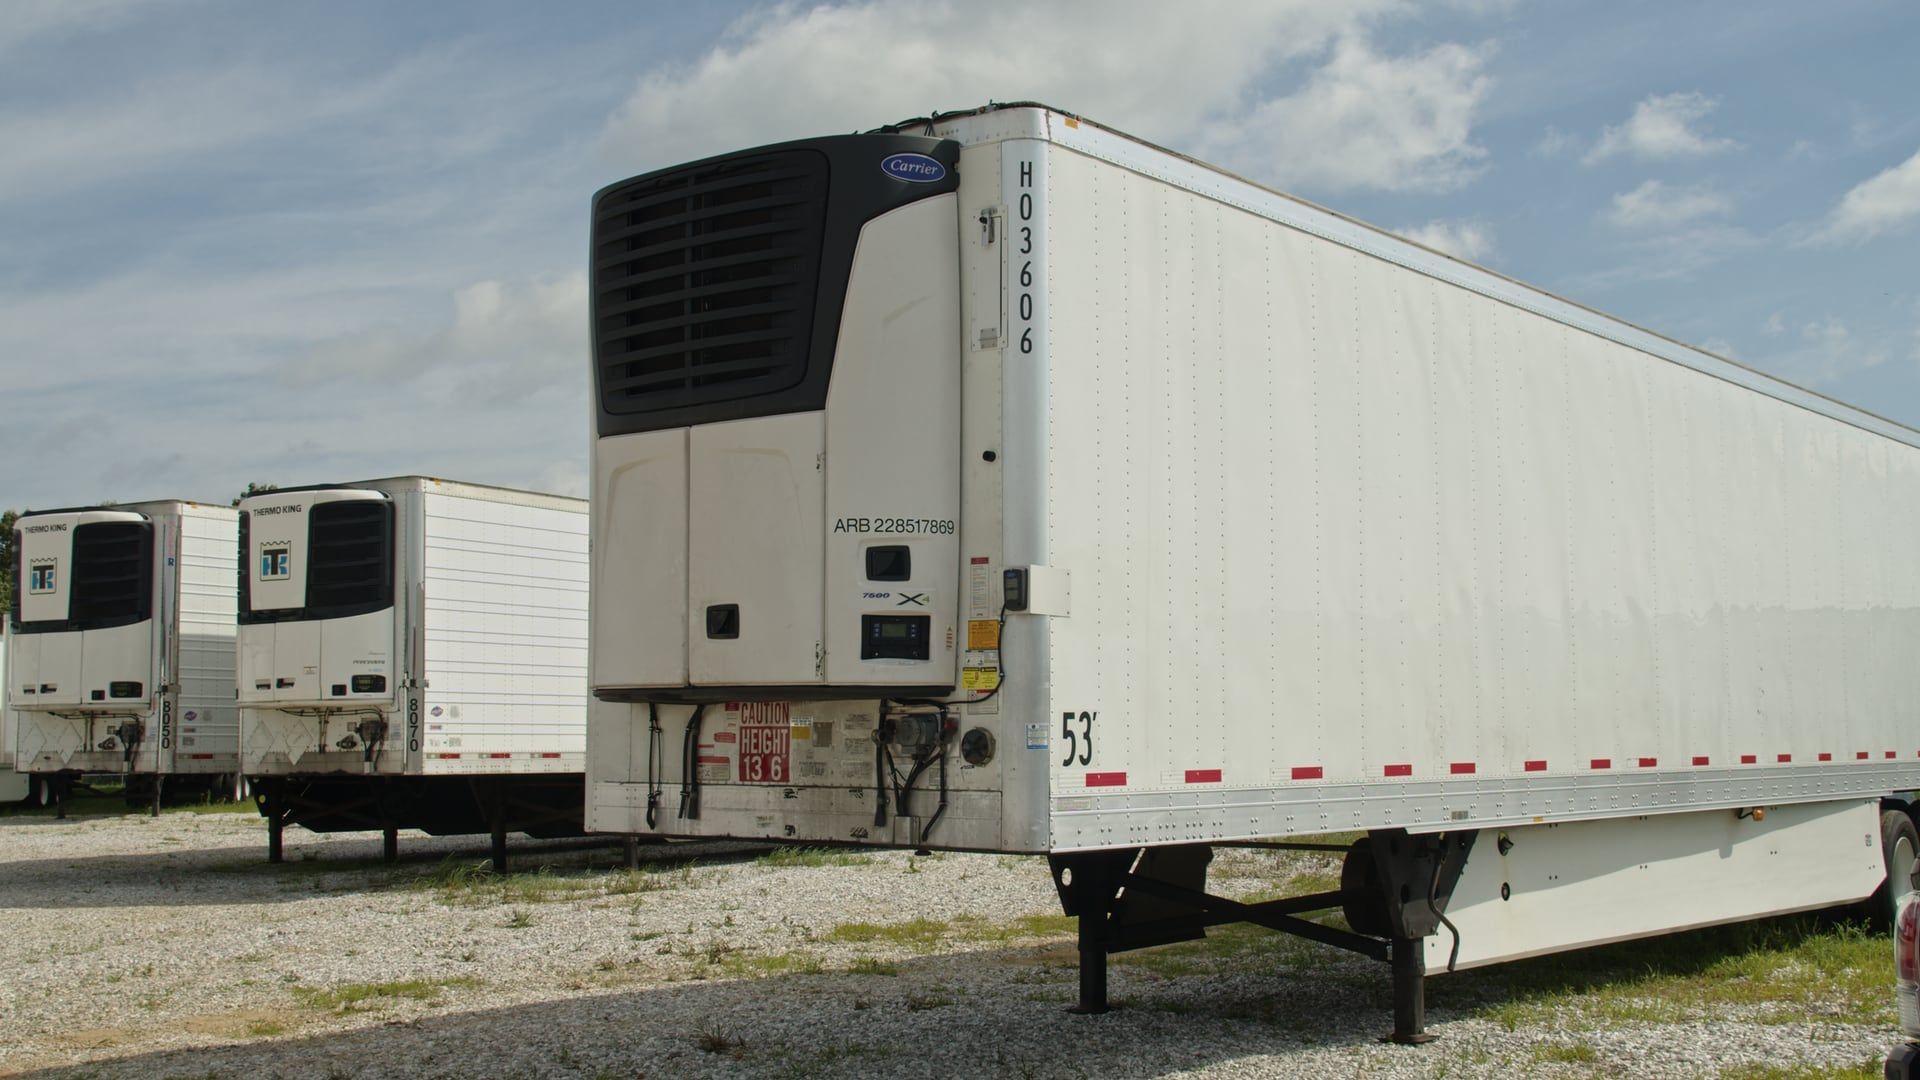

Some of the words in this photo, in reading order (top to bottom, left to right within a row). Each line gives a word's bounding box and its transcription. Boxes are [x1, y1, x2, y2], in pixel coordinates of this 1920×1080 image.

[890, 159, 938, 175] Carrier
[1020, 161, 1032, 354] H03606
[253, 506, 281, 517] THERMO
[282, 504, 302, 514] KING
[25, 524, 49, 534] THERMO
[50, 523, 67, 532] KING
[834, 518, 870, 533] ARB
[874, 518, 955, 535] 228517869
[409, 698, 419, 752] 8070
[741, 703, 790, 725] CAUTION
[741, 728, 789, 755] HEIGHT
[1062, 711, 1098, 767] 53'
